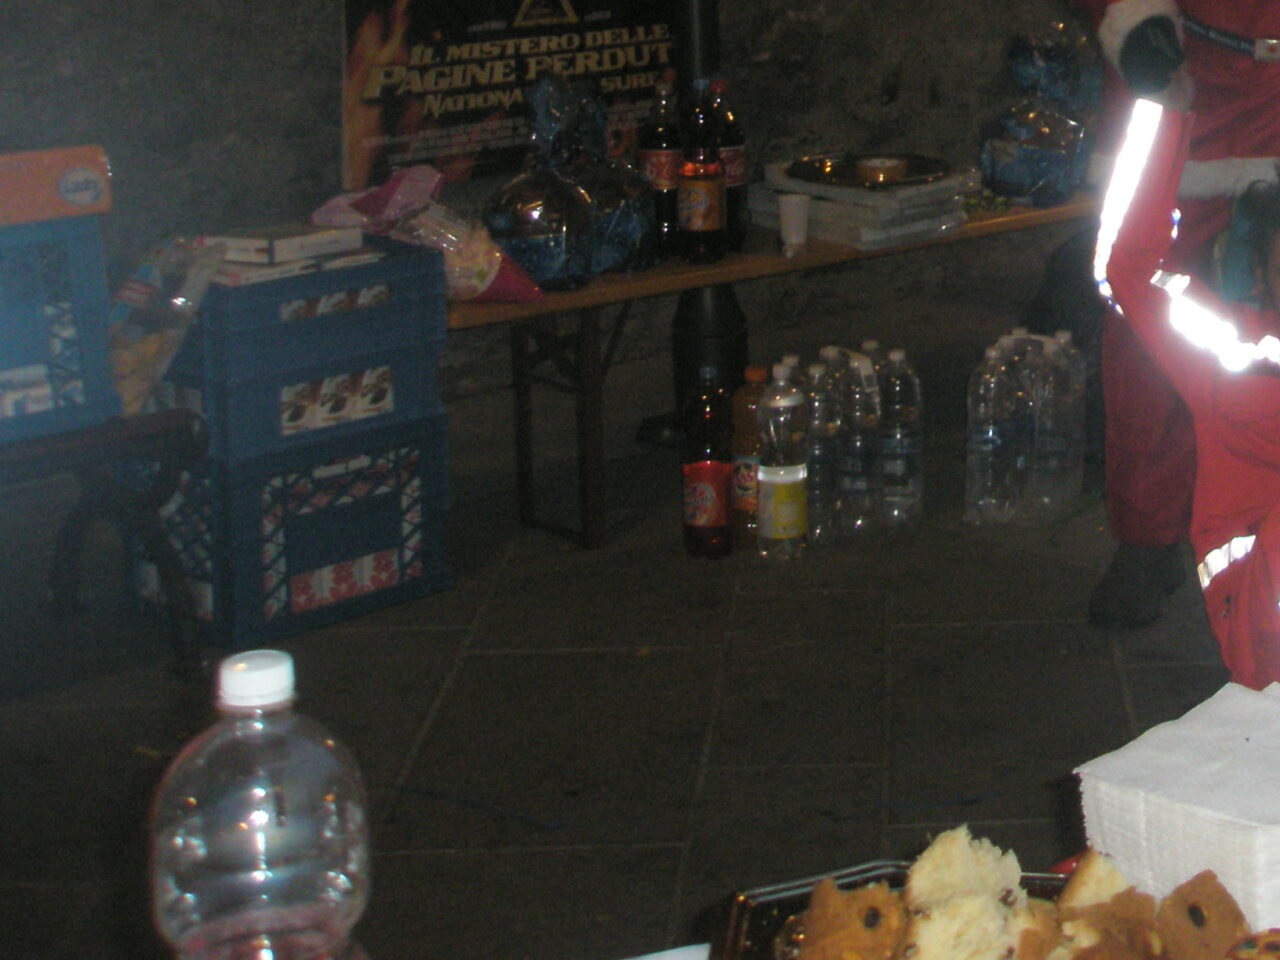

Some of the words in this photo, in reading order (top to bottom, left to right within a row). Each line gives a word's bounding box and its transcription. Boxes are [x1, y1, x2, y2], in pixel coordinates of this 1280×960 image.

[409, 44, 440, 65] IL
[446, 33, 580, 60] MISTERO
[583, 23, 672, 46] DELLE
[360, 59, 517, 99] PAGINE
[524, 42, 673, 80] PERDUT
[422, 89, 524, 117] NATIONA
[600, 71, 659, 92] SURE
